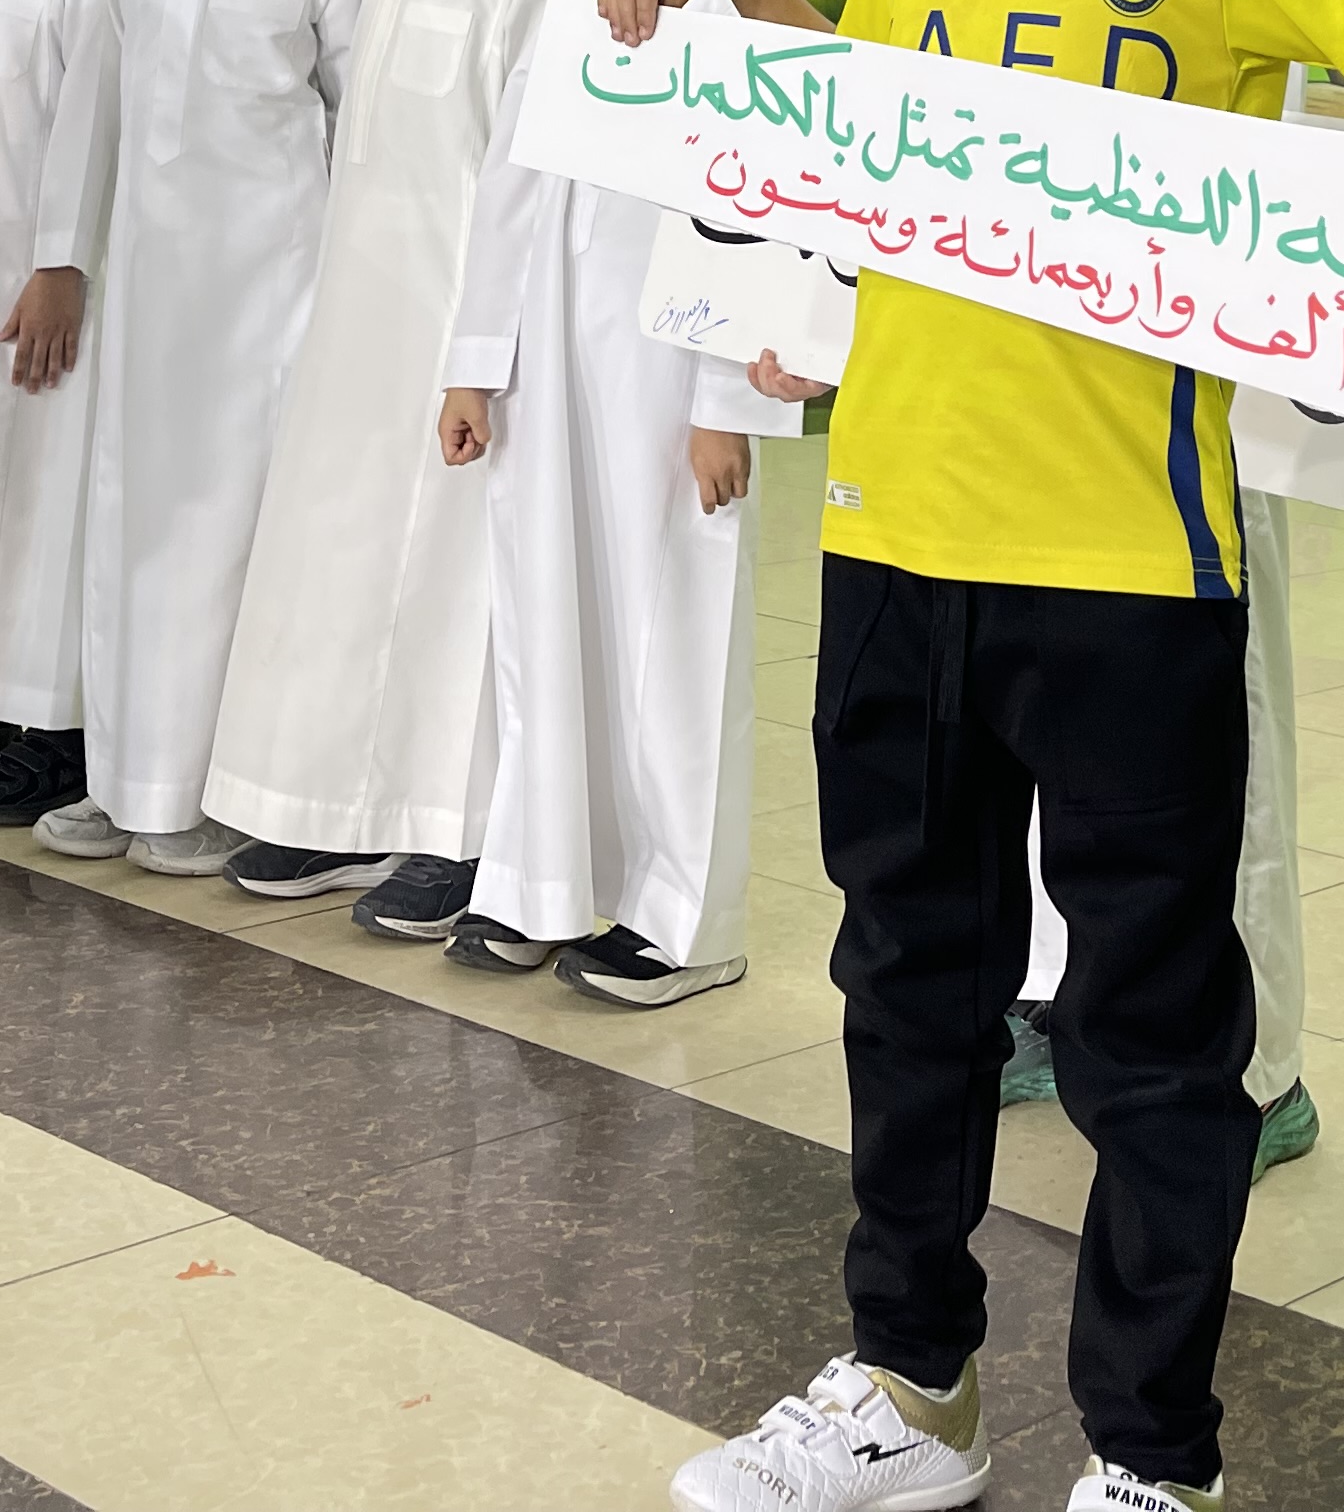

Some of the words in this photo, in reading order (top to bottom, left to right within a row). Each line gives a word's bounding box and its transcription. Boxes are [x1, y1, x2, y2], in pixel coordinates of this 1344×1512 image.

[582, 42, 855, 166] بالكلمات
[862, 92, 985, 183] تمثل
[999, 133, 1261, 261] اللفظية
[733, 1457, 799, 1505] SPORT
[1105, 1484, 1181, 1512] WANDE
